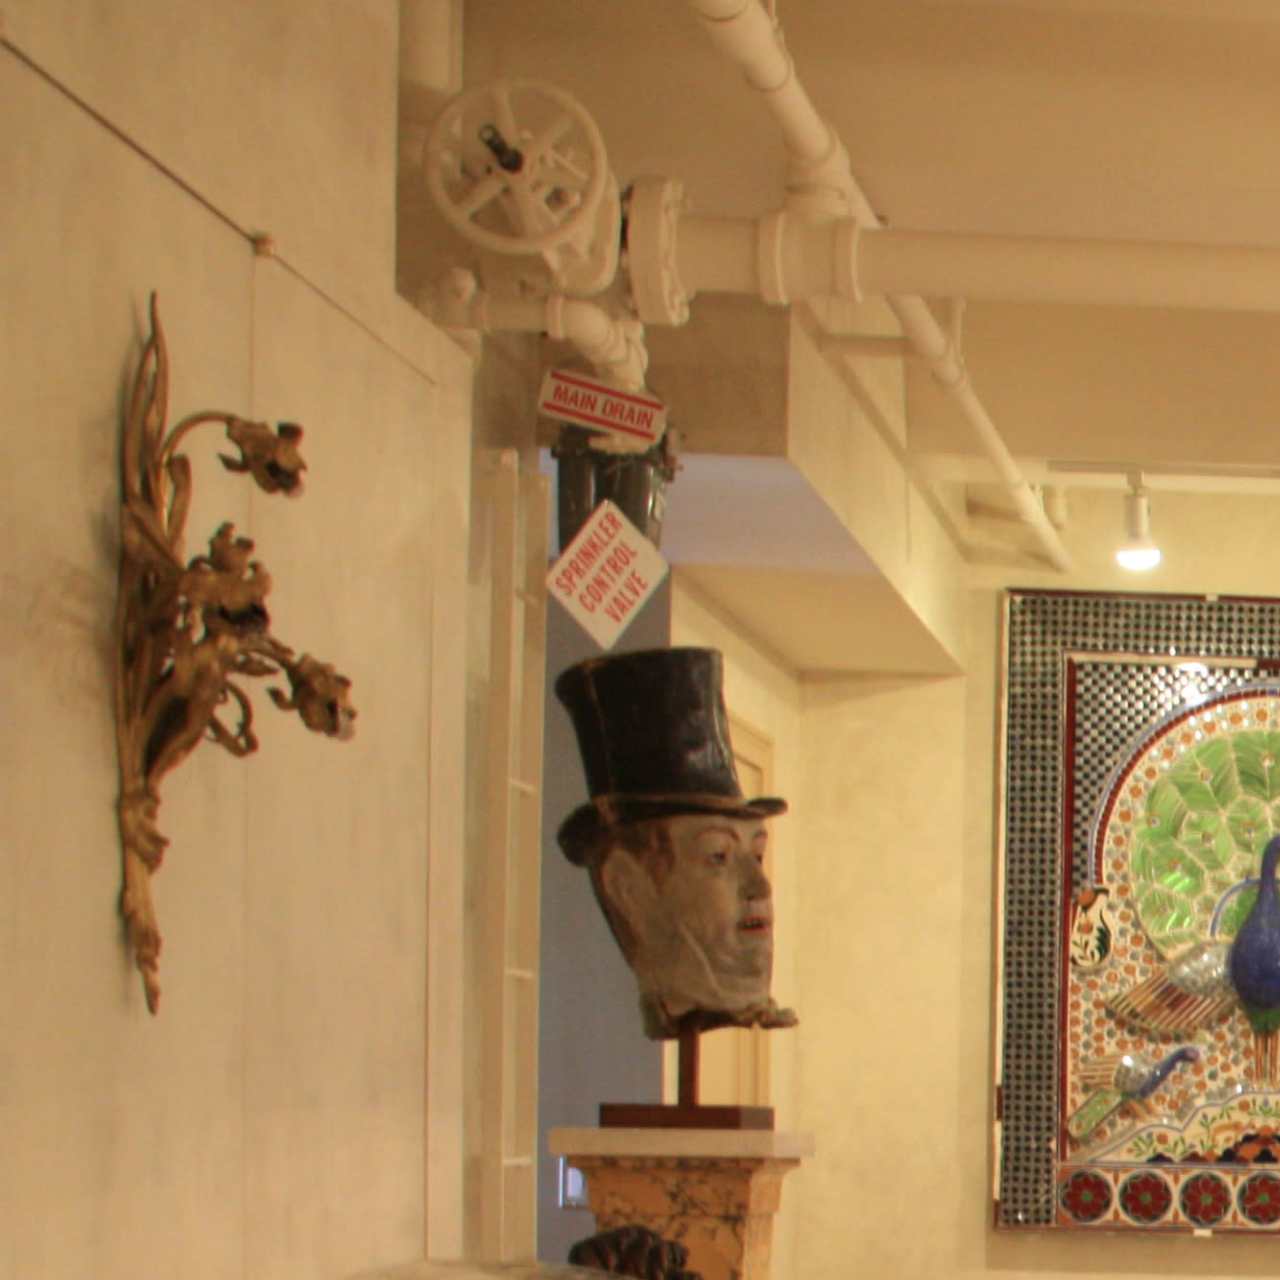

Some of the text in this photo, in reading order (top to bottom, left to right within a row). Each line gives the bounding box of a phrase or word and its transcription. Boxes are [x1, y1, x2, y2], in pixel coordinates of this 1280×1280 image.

[553, 384, 654, 430] MAIN DRAIN
[555, 511, 622, 597] SPRINKLER
[578, 541, 637, 615] CONTROL
[604, 570, 648, 625] VALVE
